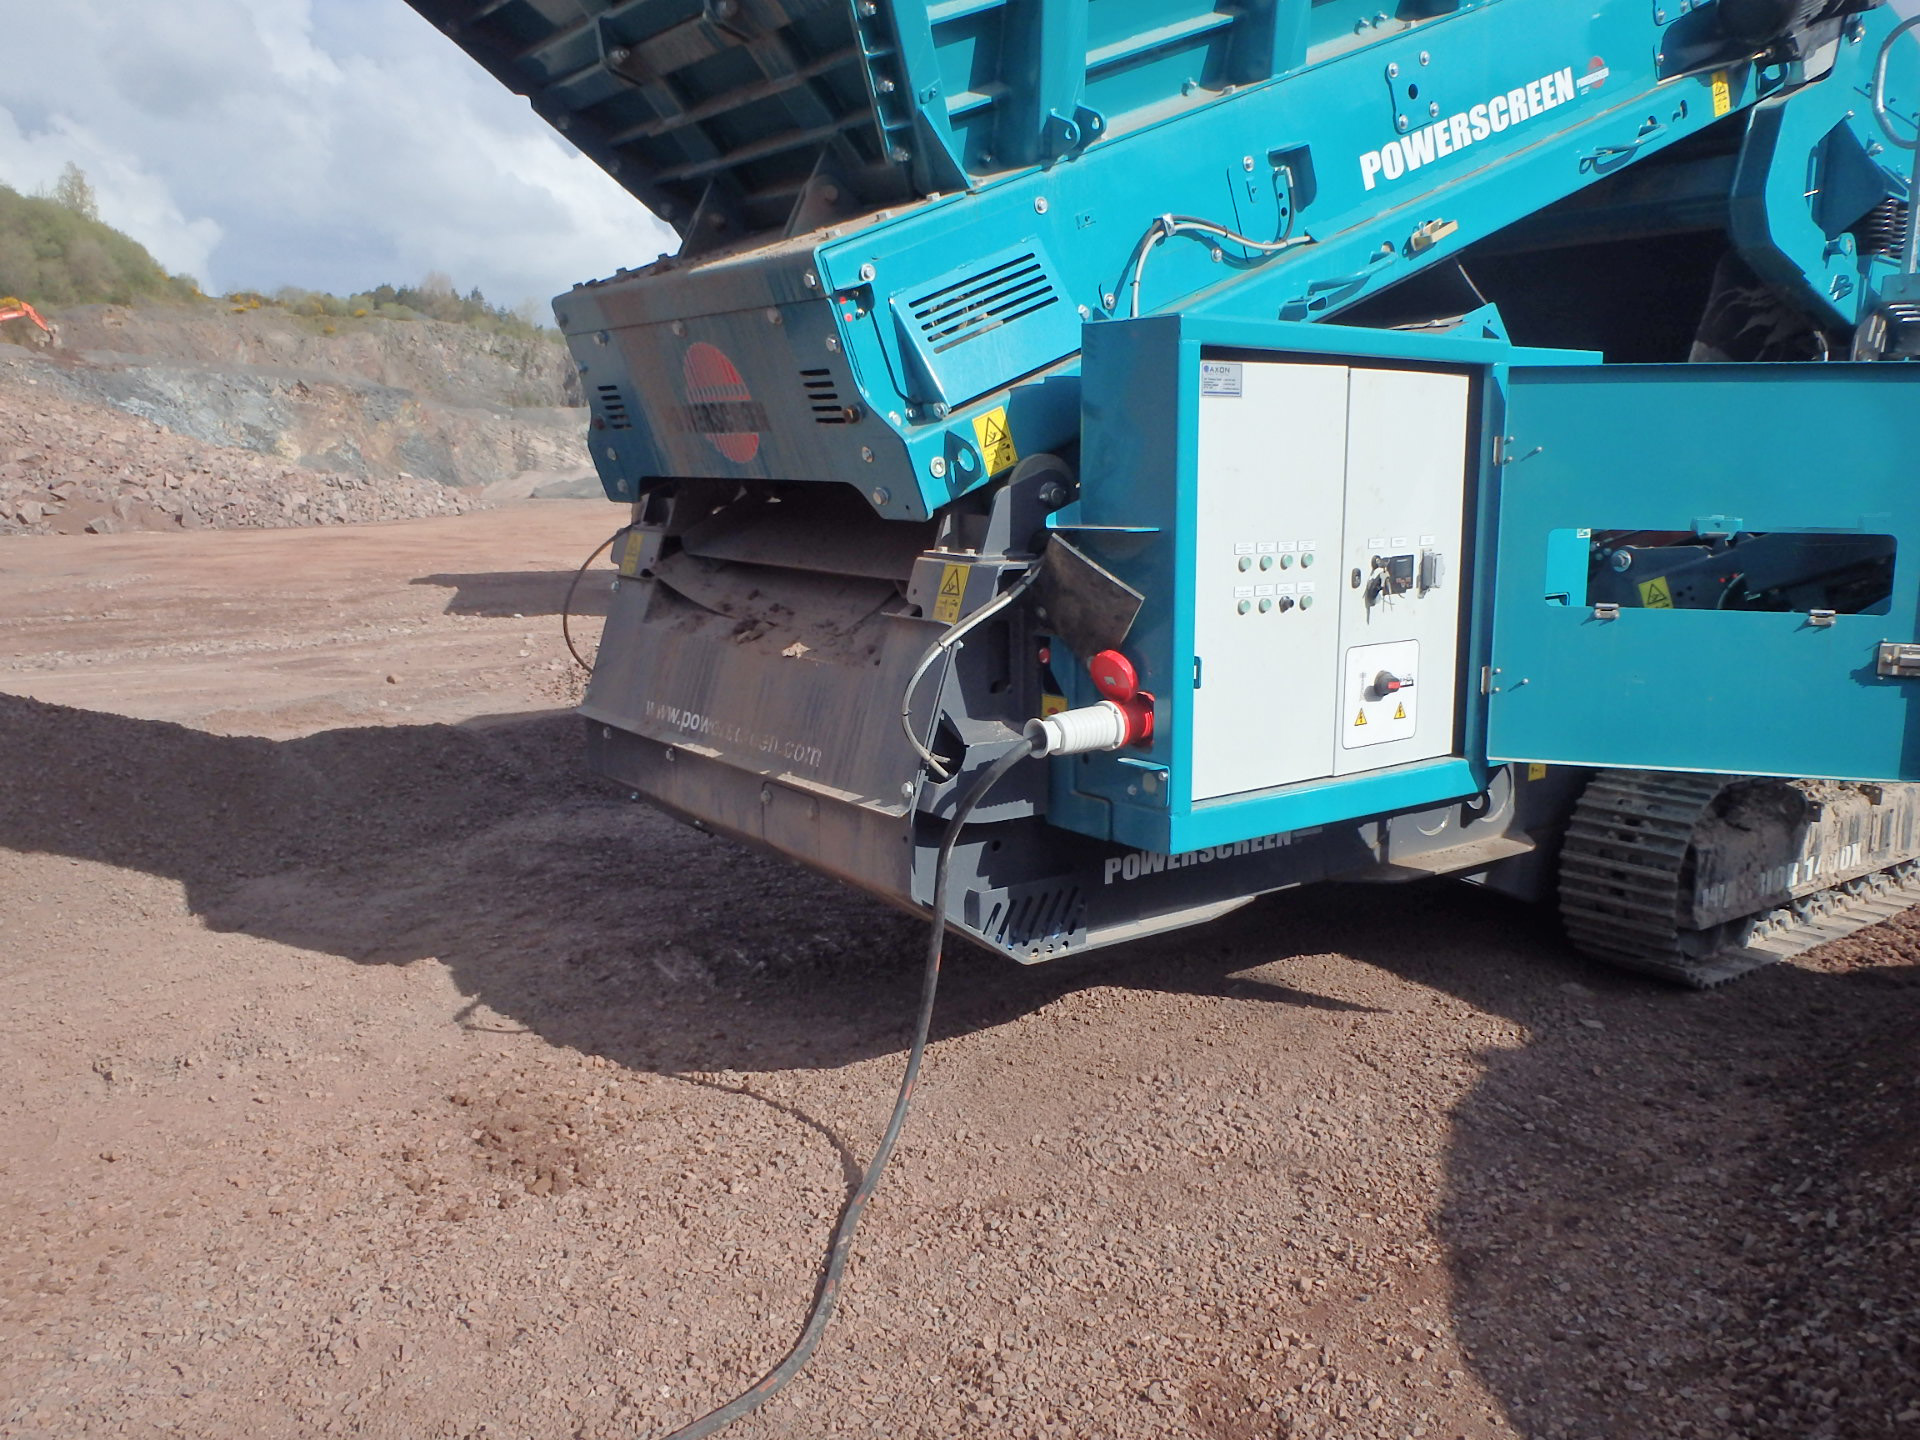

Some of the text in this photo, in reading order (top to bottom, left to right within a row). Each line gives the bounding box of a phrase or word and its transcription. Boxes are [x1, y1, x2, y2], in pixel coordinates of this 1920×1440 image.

[1360, 67, 1575, 190] POWERSCREEN
[1210, 366, 1231, 374] AXON
[646, 700, 822, 767] www.powerscen.com
